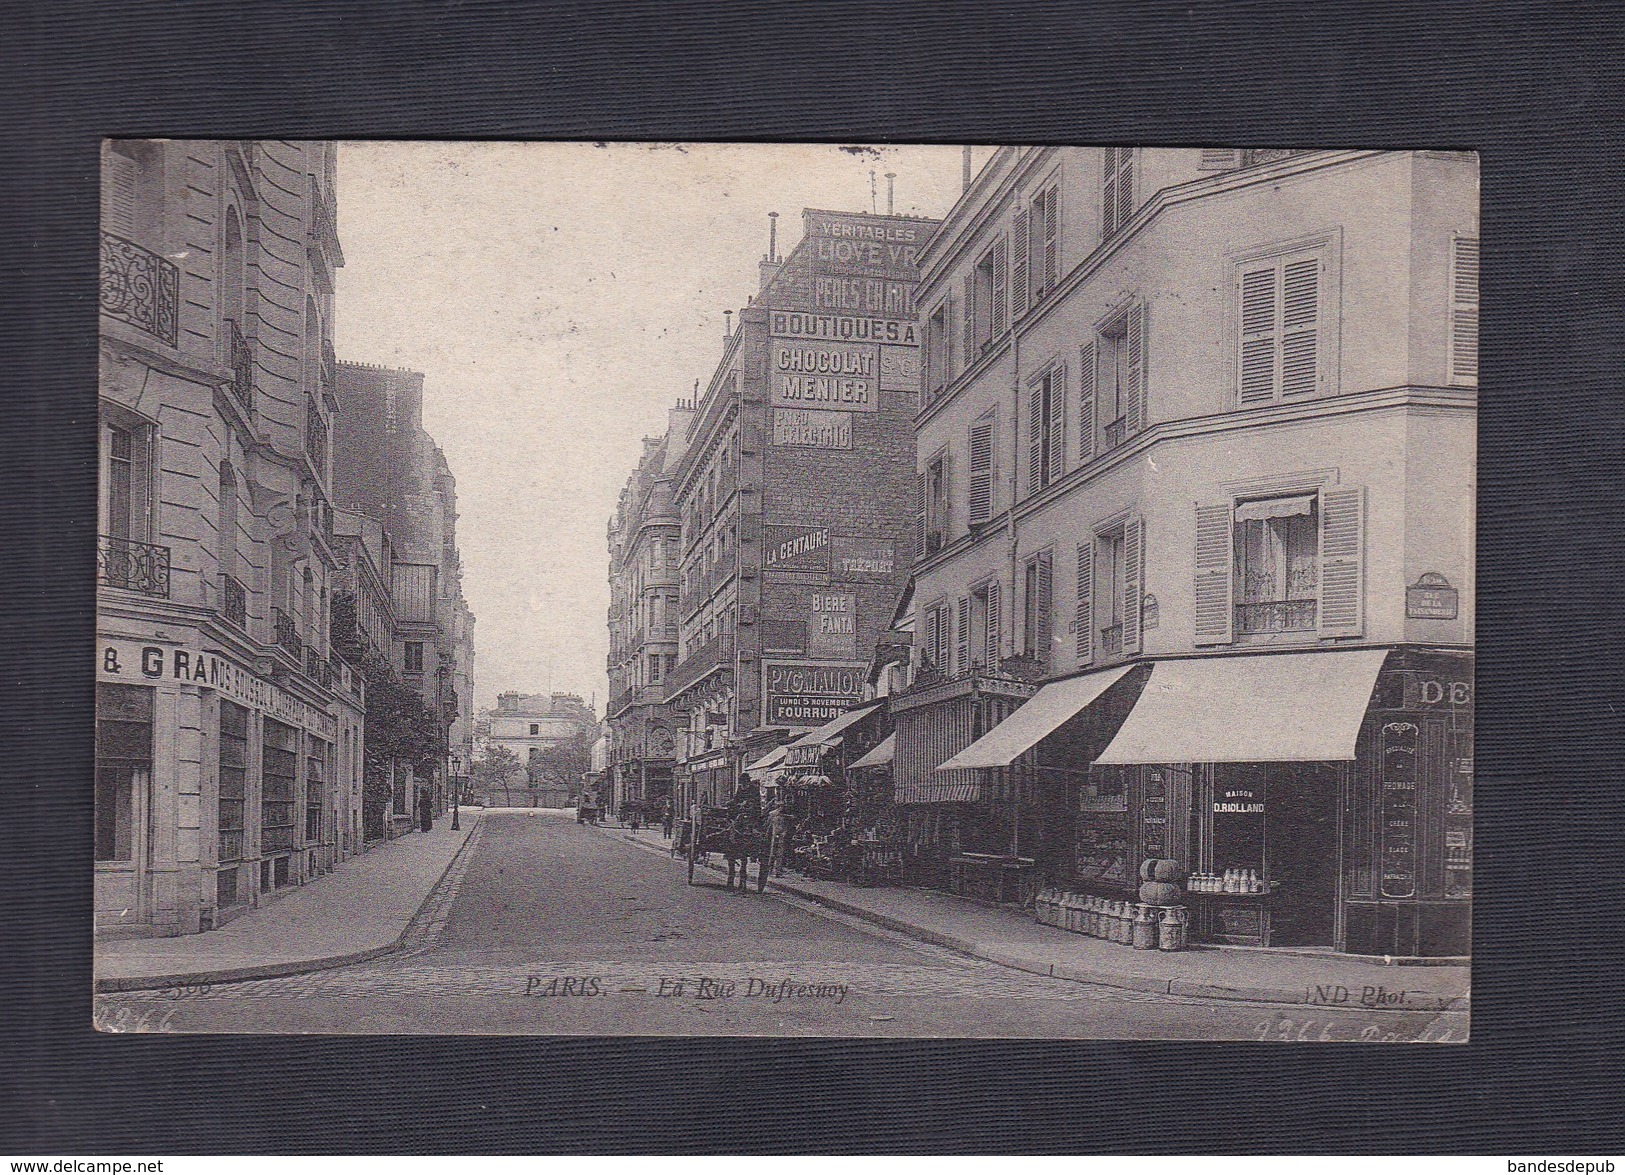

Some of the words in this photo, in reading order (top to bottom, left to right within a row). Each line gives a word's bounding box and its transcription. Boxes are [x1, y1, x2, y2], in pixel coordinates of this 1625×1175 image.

[774, 313, 899, 341] BOUTIQUES
[778, 349, 873, 376] CHOCOLAT
[782, 376, 868, 403] MENIER
[767, 549, 777, 565] LA
[780, 529, 828, 560] CENTAURE
[820, 614, 855, 634] FANTA
[103, 646, 122, 674] &
[141, 646, 230, 691] GRANDS
[768, 669, 865, 695] PYGMALION
[778, 706, 849, 719] FOURRURE
[803, 697, 810, 705] 5
[1225, 790, 1253, 798] MAISON
[1383, 781, 1415, 790] FROMAGE
